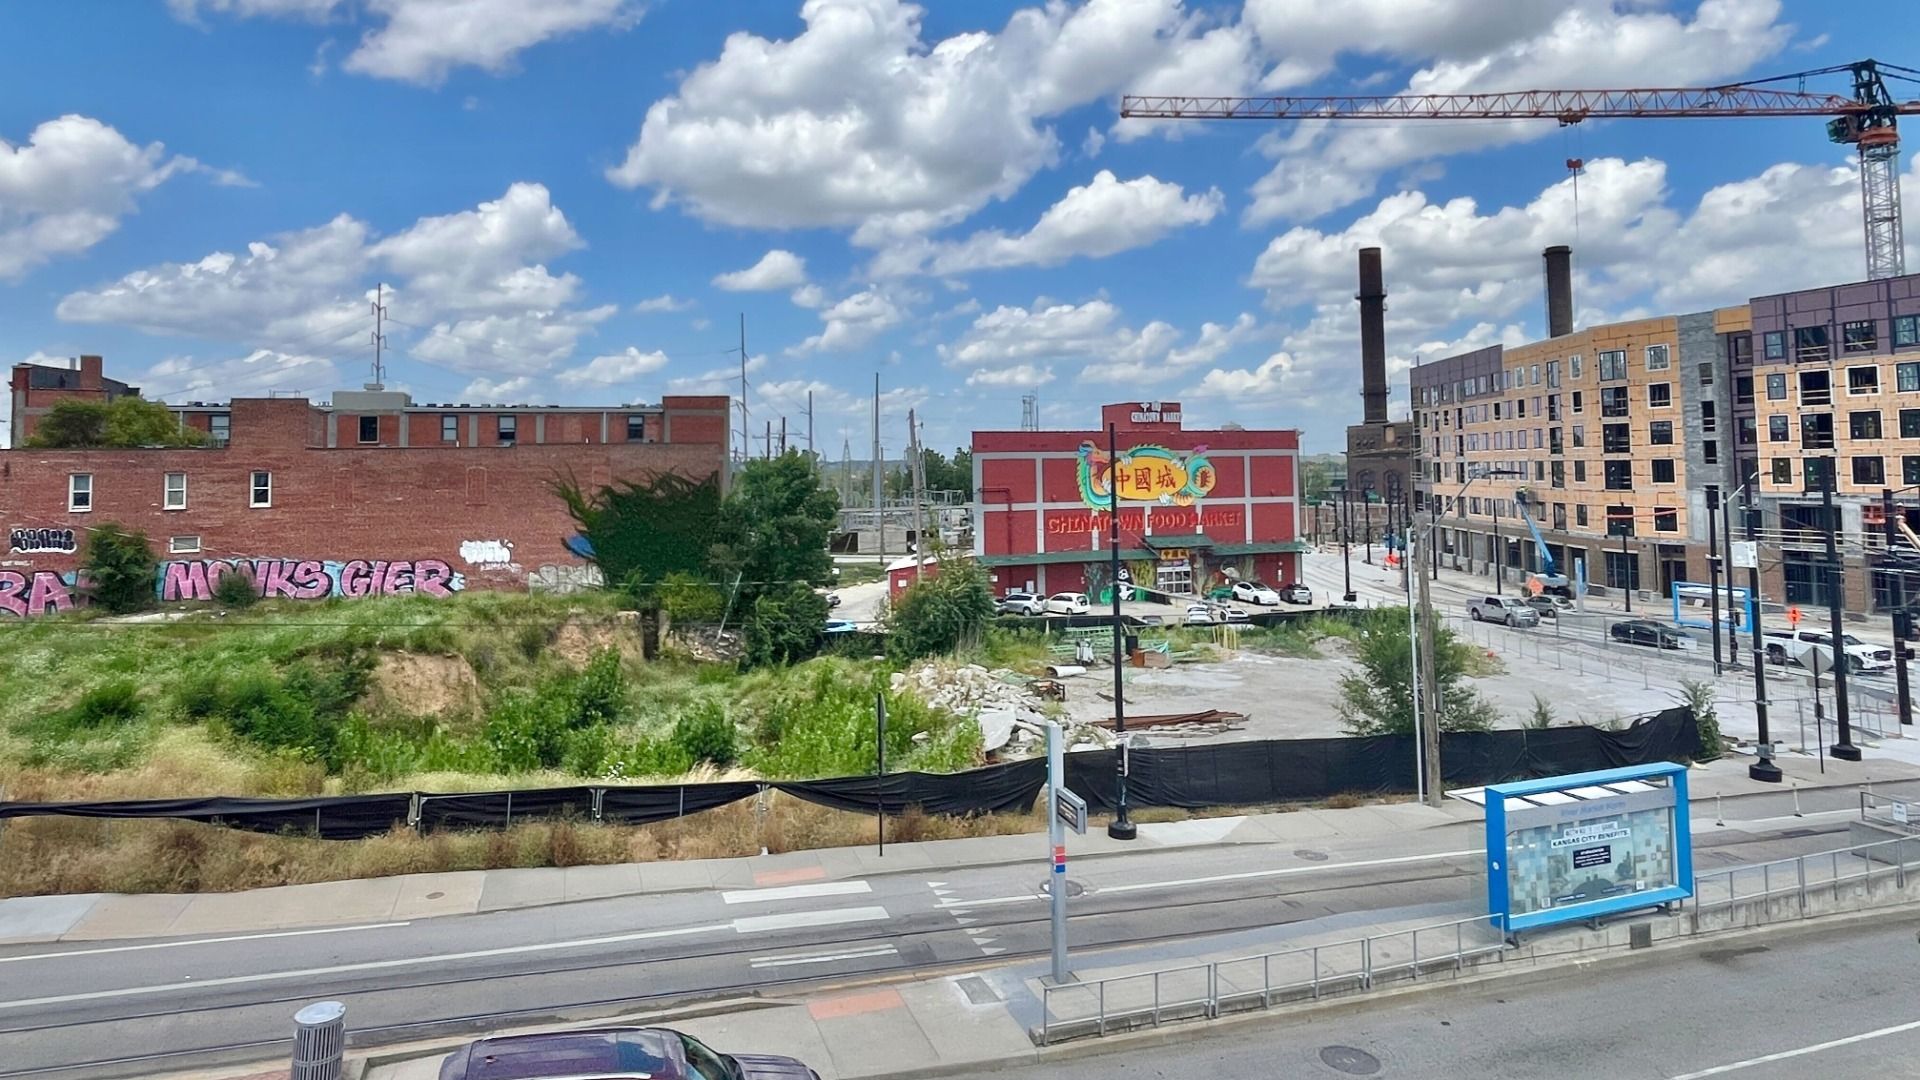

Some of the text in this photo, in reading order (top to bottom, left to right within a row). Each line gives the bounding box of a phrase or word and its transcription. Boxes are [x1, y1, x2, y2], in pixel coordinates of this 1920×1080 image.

[1115, 465, 1176, 492] 中國城
[1049, 512, 1241, 533] CHINATOWN FOOD MARKET
[1553, 837, 1580, 847] KANSAS
[1581, 834, 1597, 844] CITY
